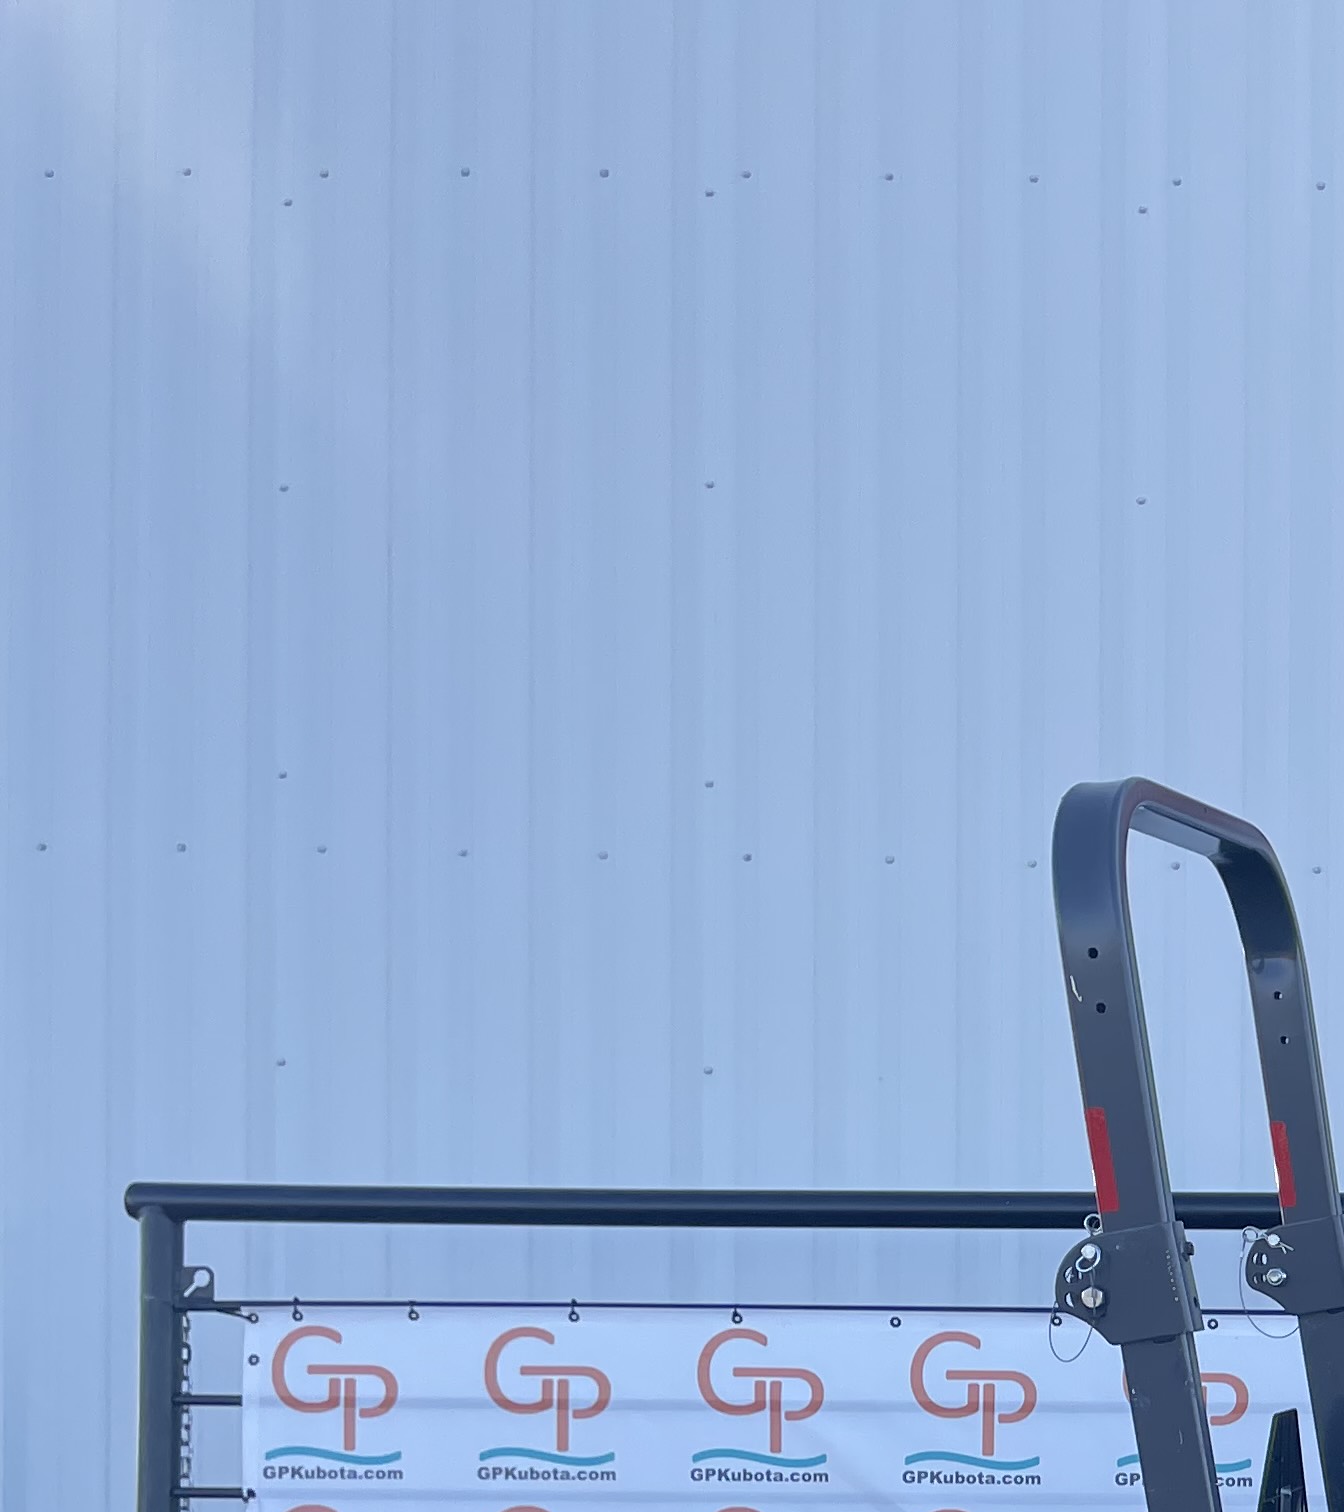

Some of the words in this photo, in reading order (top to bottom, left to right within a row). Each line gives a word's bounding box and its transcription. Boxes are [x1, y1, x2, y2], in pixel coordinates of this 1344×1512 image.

[272, 1326, 397, 1451] GP
[484, 1328, 610, 1451] GP
[698, 1329, 824, 1453] GP
[911, 1332, 1036, 1456] GP
[263, 1466, 403, 1480] GPKubota.com
[477, 1467, 616, 1480] GPKubota.com
[691, 1468, 828, 1482] GPKubota.com
[903, 1471, 1041, 1485] GPKubota.com
